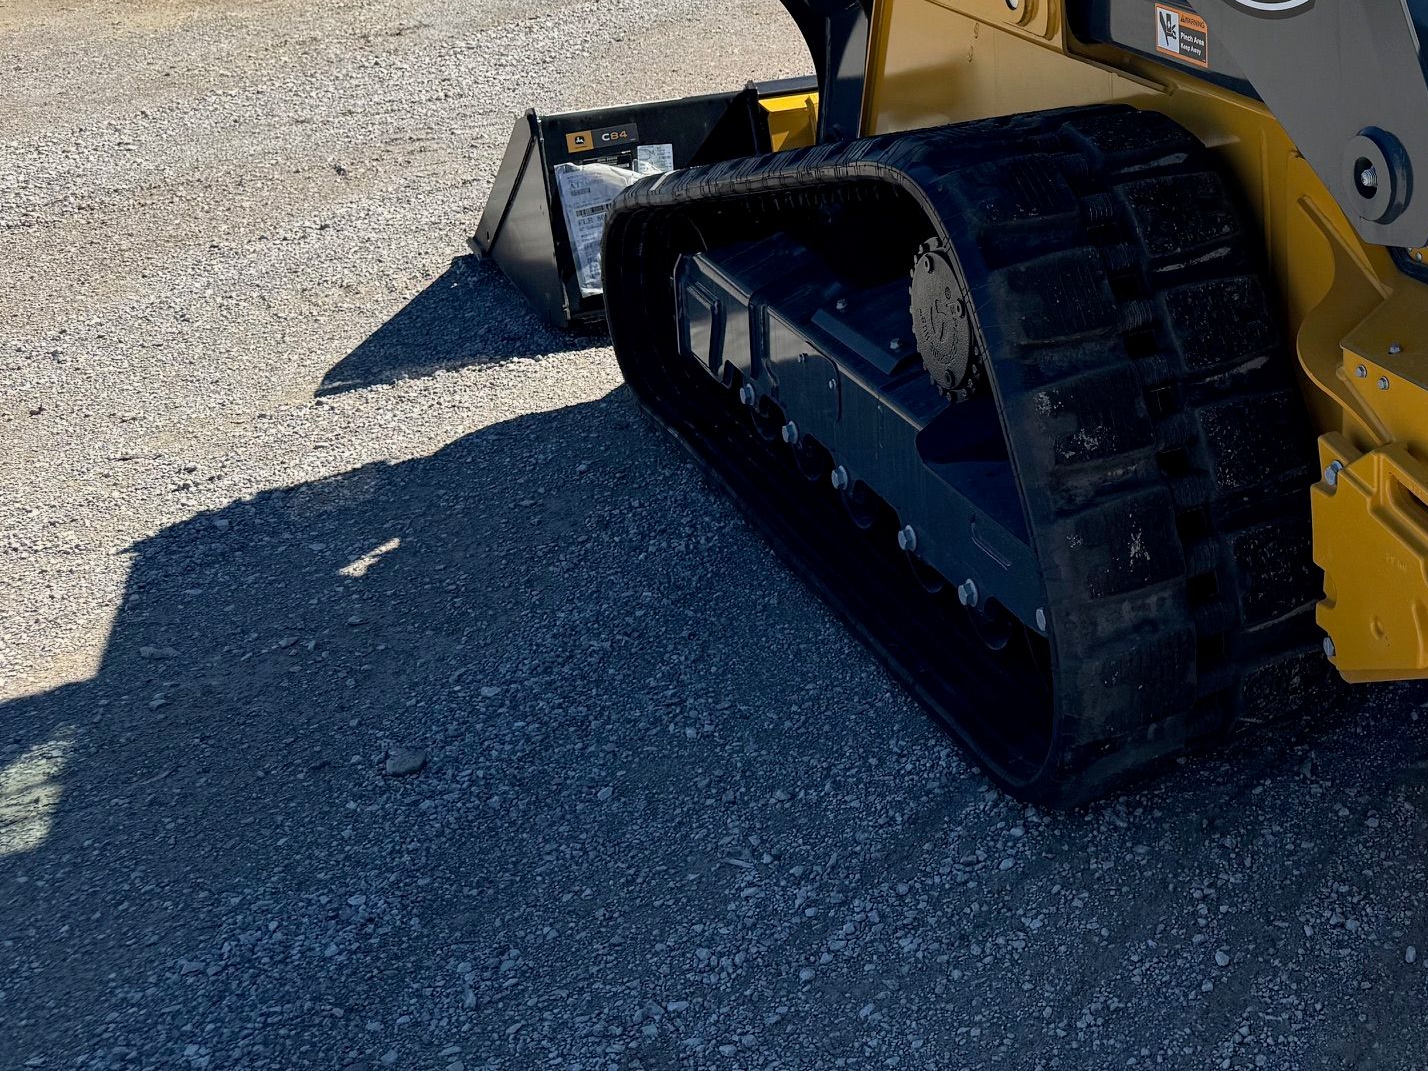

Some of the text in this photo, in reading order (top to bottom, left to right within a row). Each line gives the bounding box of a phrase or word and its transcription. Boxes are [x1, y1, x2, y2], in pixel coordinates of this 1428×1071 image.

[1180, 31, 1205, 47] Pinch Area
[1180, 43, 1202, 56] Keep Away
[601, 130, 628, 142] C84
